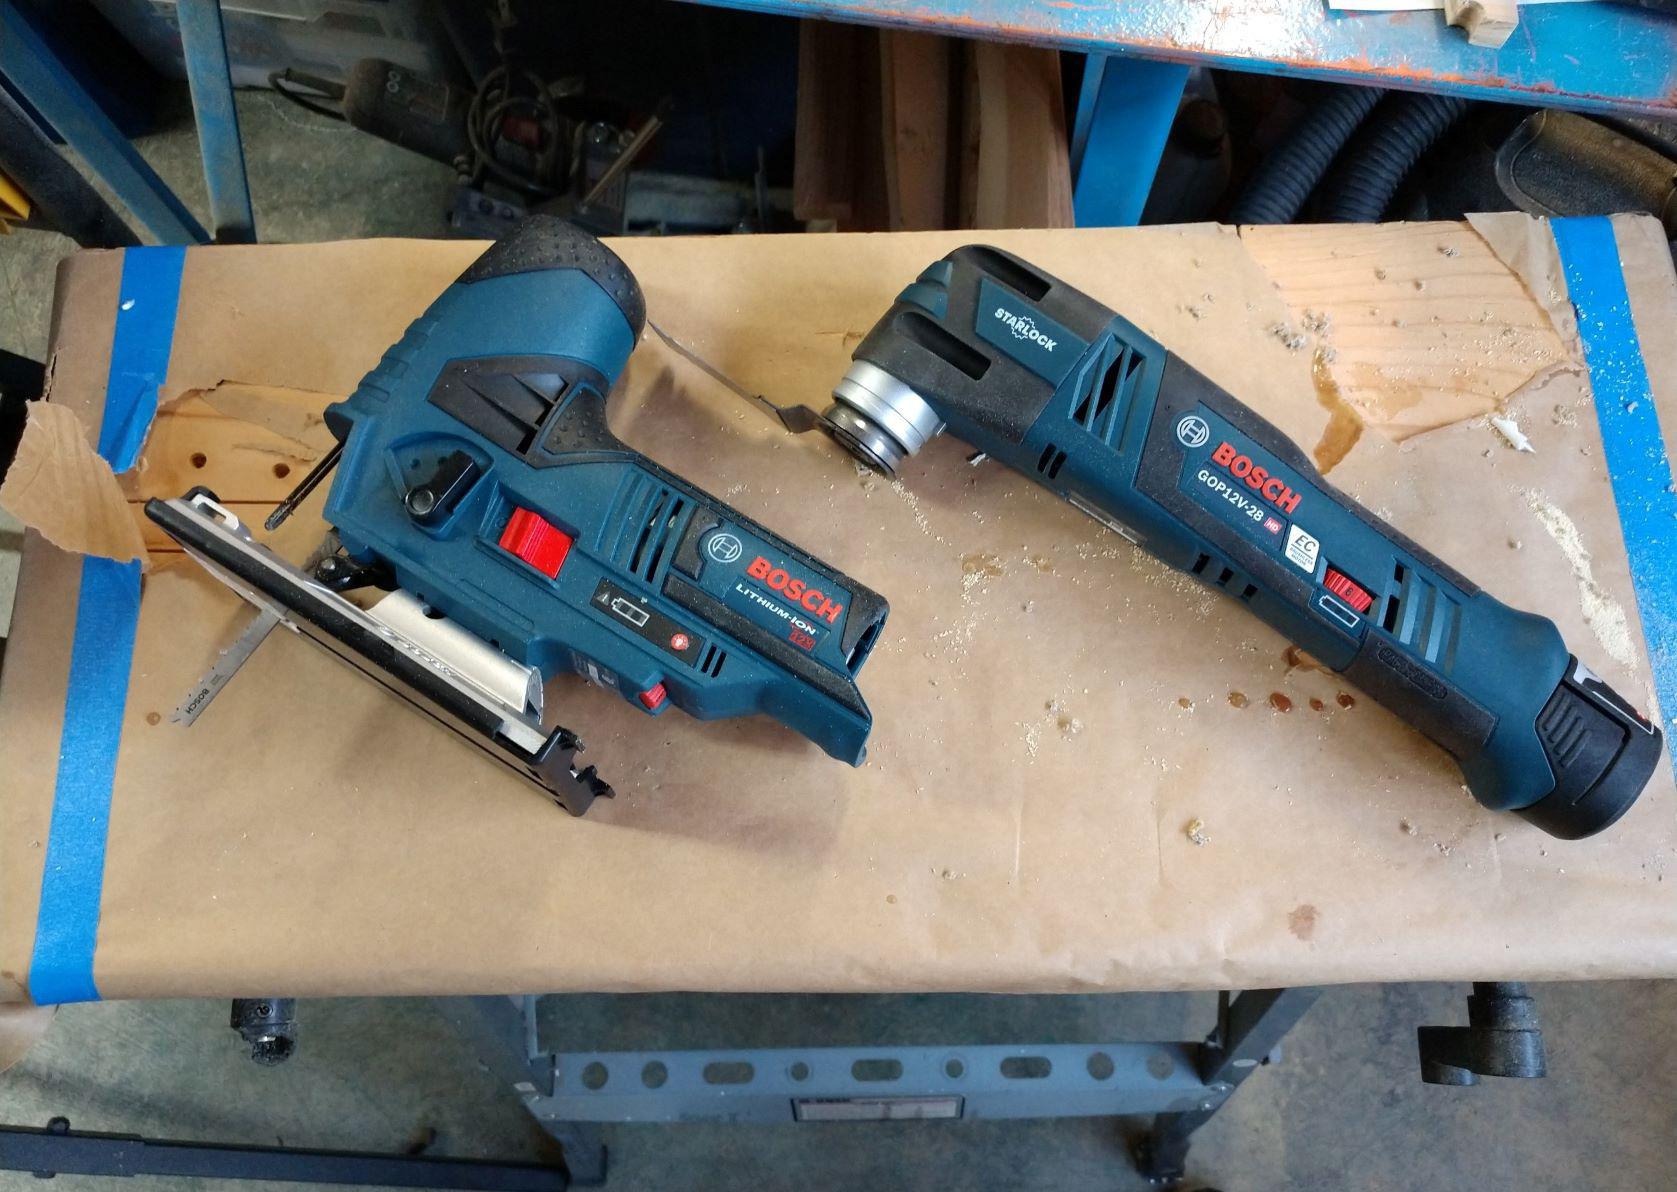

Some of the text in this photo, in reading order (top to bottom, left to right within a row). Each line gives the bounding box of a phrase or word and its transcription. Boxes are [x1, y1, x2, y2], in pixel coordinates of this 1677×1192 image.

[994, 308, 1058, 352] STARLOCK
[1197, 469, 1279, 532] GOP12V-28 HD
[1211, 441, 1302, 515] BOSCH
[1294, 534, 1316, 552] EC
[735, 583, 817, 635] LITHIUM-ION
[746, 556, 843, 624] BOSCH
[185, 688, 210, 714] BOSCH
